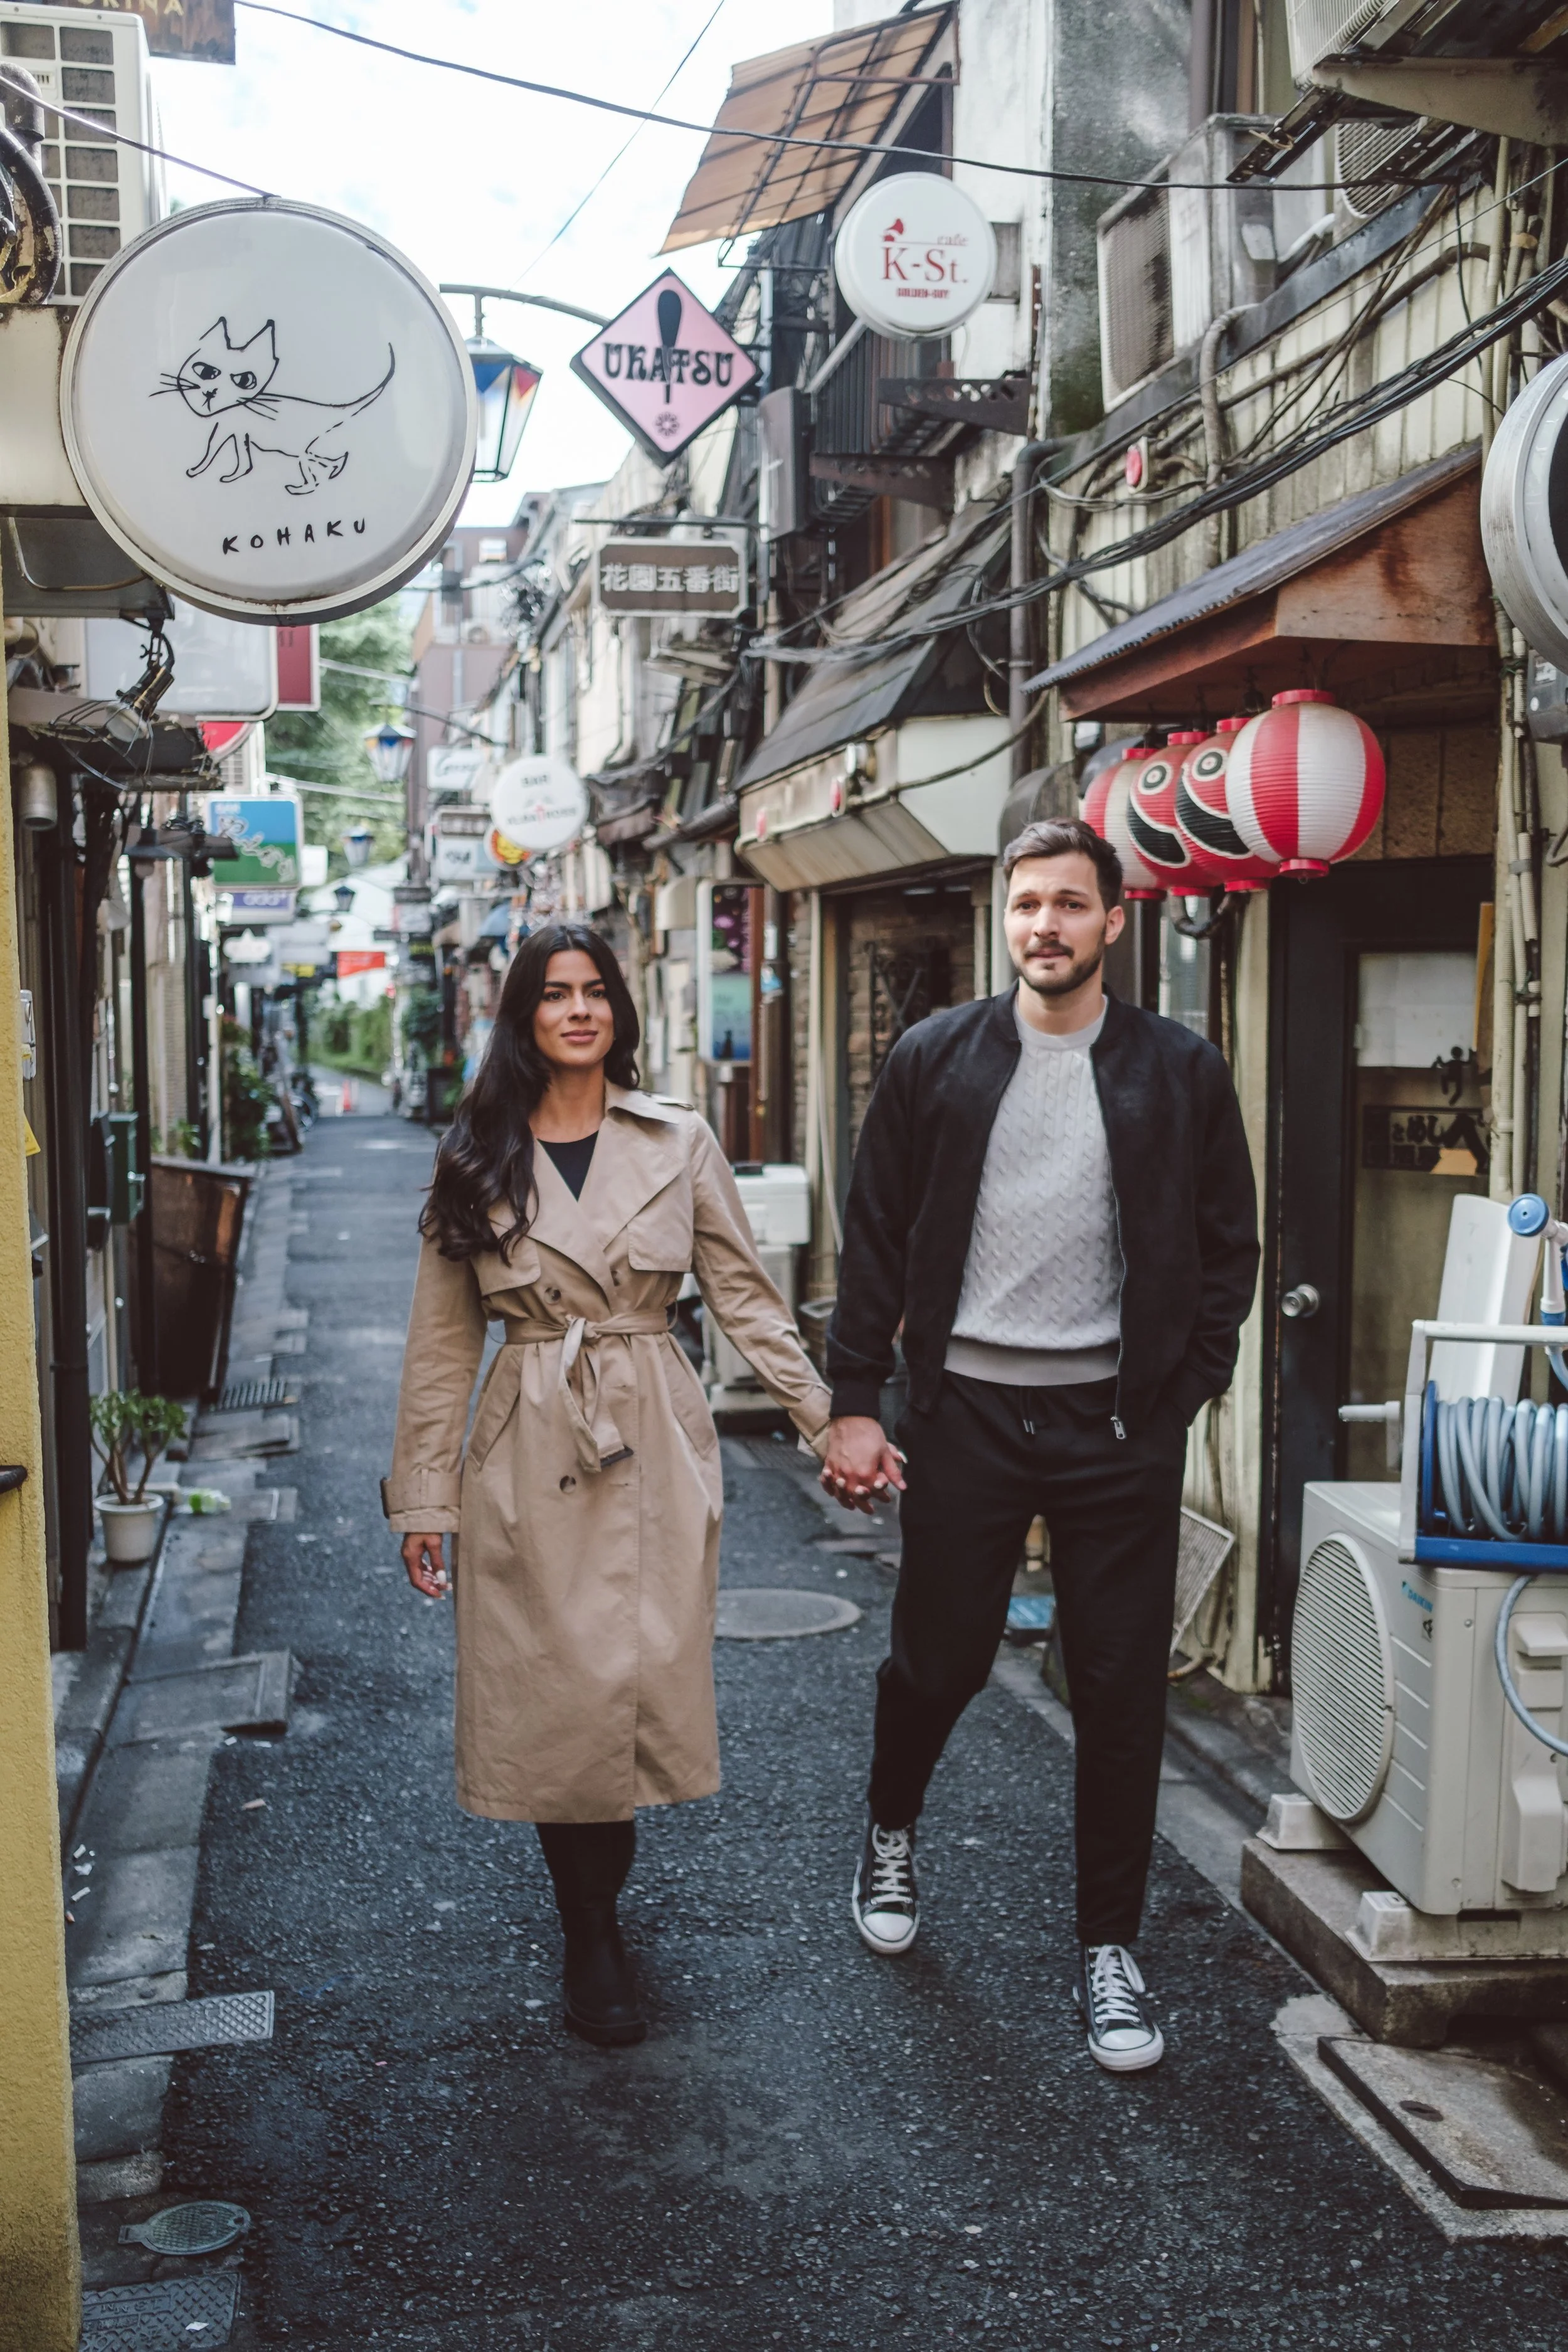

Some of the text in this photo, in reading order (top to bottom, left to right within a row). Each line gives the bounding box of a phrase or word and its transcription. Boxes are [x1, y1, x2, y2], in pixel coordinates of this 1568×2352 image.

[882, 246, 968, 283] K-St.
[603, 343, 733, 387] UKATSU
[222, 517, 365, 554] KOHAKU
[600, 562, 739, 593] 花園五番街
